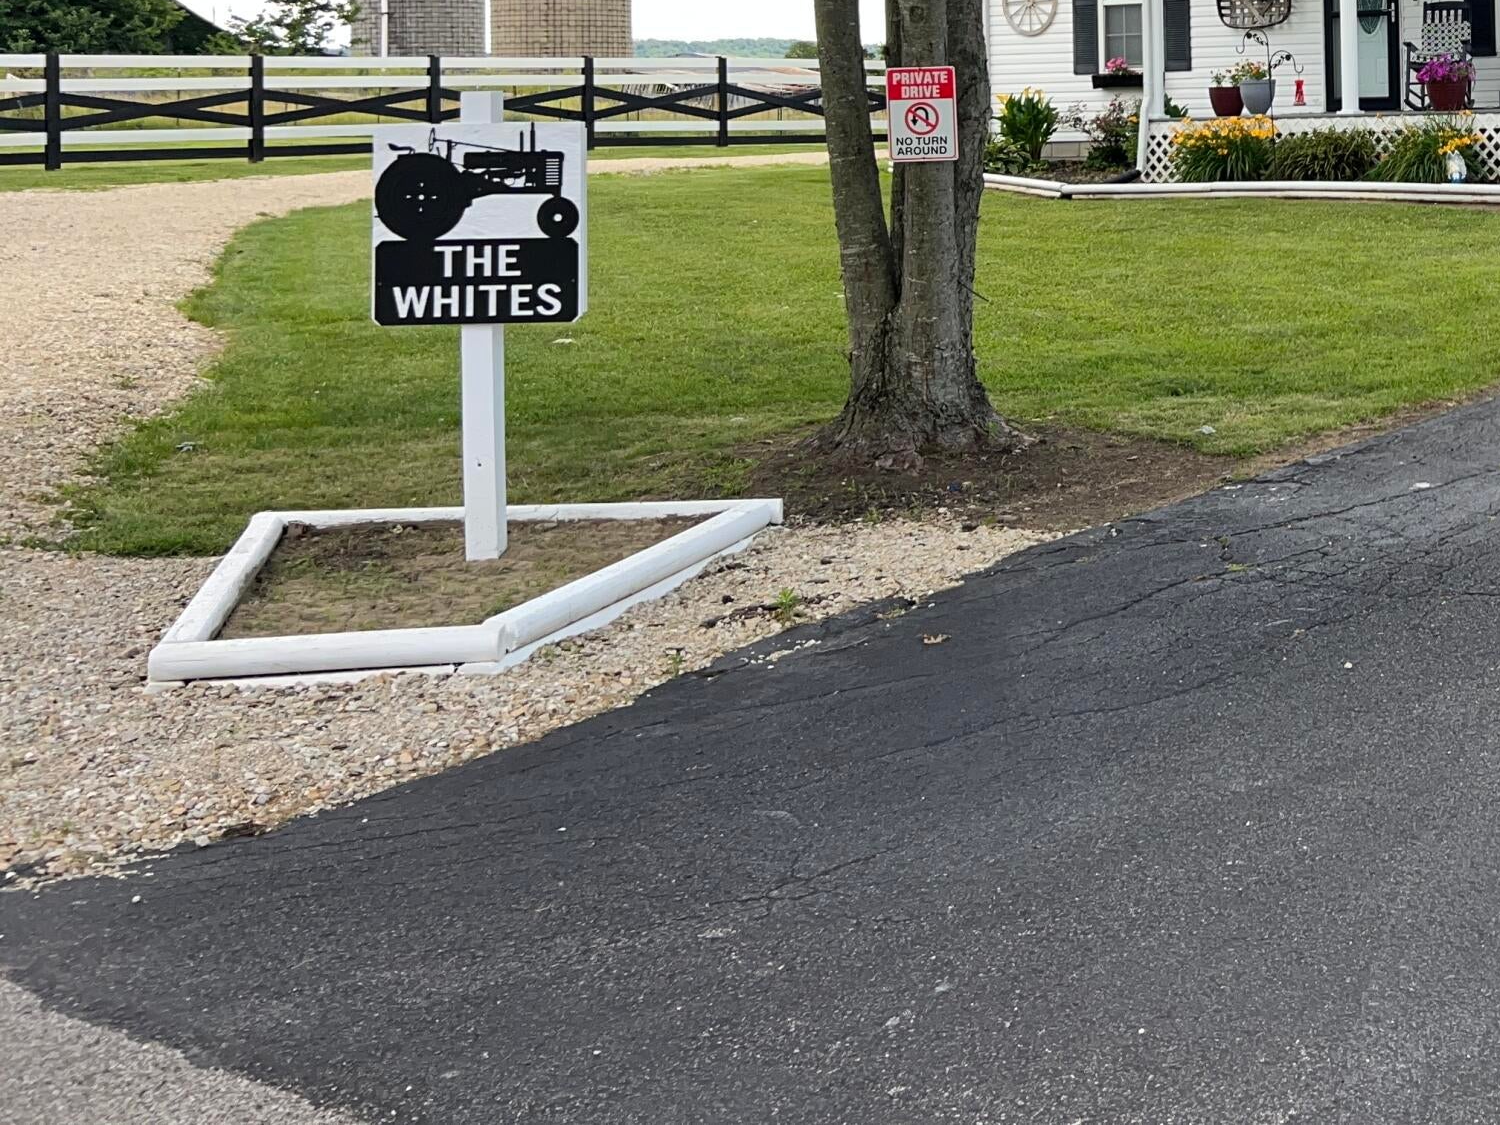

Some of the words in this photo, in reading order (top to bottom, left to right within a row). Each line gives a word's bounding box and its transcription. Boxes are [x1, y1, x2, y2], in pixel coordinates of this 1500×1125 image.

[892, 71, 948, 85] PRIVATE
[901, 85, 940, 99] DRIVE
[896, 137, 913, 146] NO
[916, 136, 948, 145] TURN
[897, 146, 947, 155] AROUND
[433, 244, 521, 277] THE
[392, 283, 562, 318] WHITES
